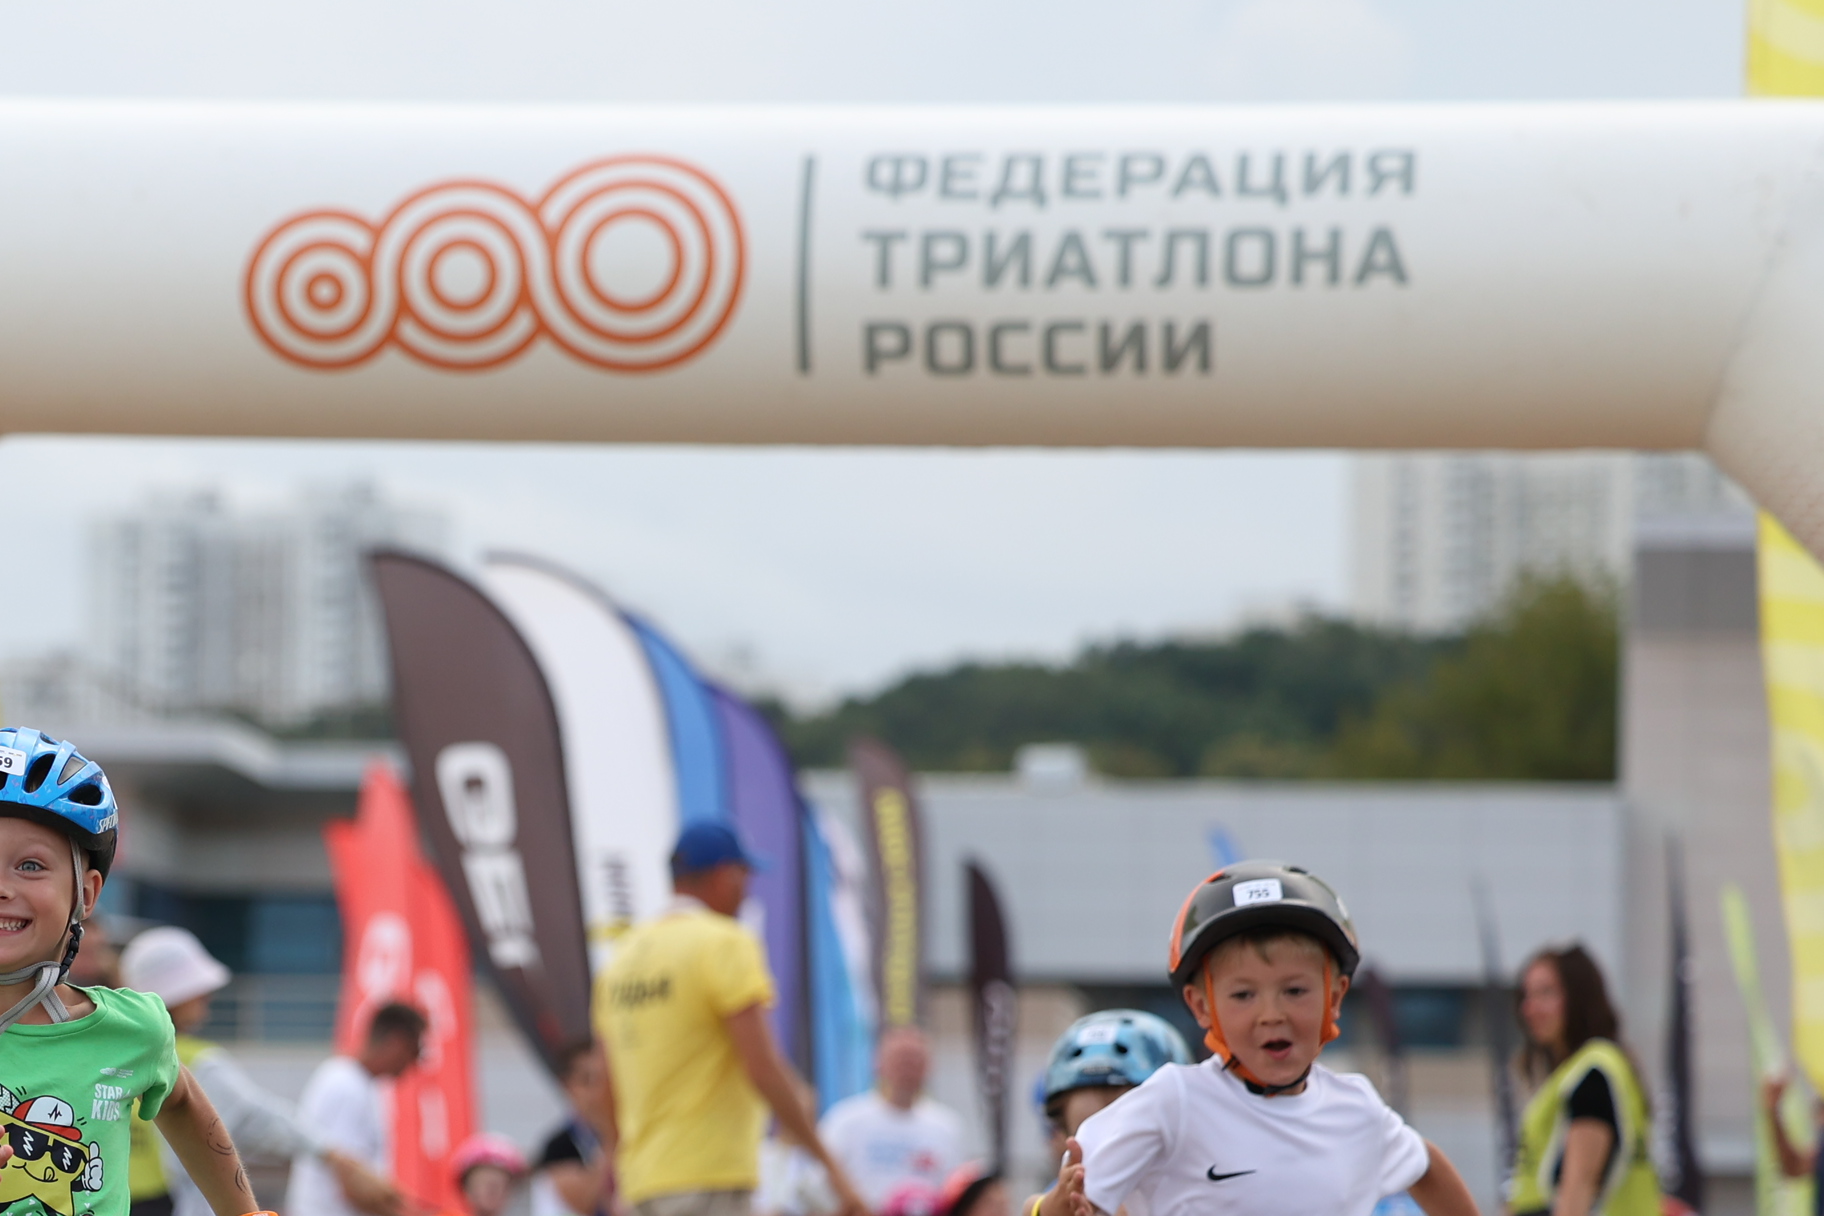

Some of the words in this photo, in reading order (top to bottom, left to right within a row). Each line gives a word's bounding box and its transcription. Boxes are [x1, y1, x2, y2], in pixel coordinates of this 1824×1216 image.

[863, 150, 1418, 208] ФЕДЕРАЦИЯ
[861, 226, 1412, 295] ТРИАТЛОНА
[862, 320, 1216, 379] РОССИИ
[90, 1098, 121, 1121] KIDS
[94, 1083, 124, 1100] STAR
